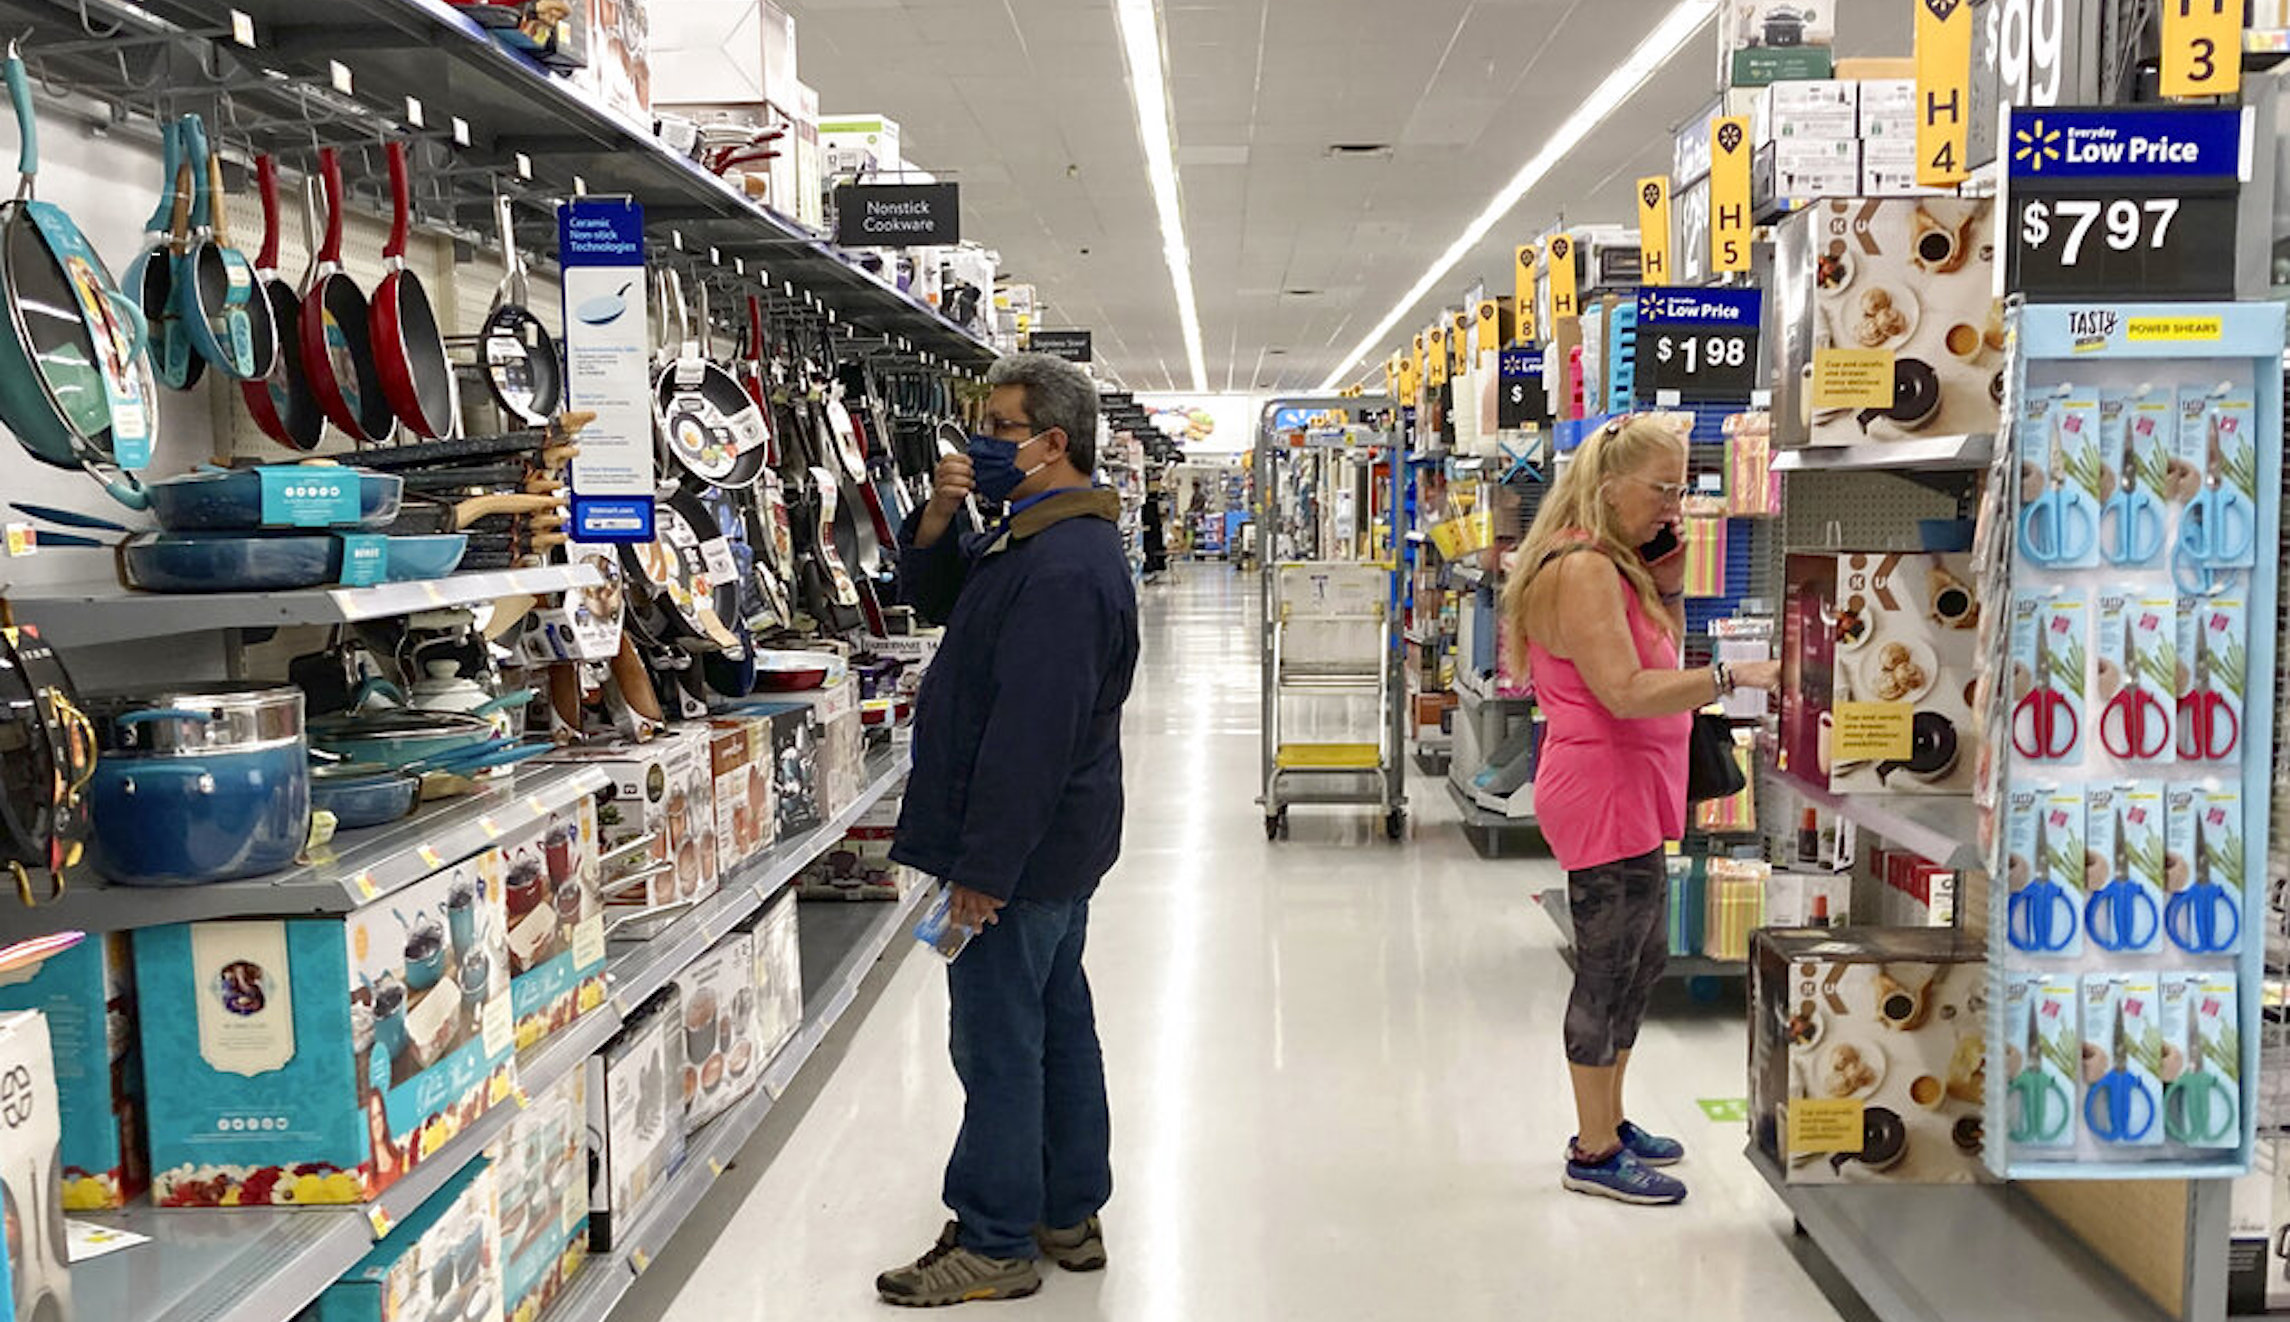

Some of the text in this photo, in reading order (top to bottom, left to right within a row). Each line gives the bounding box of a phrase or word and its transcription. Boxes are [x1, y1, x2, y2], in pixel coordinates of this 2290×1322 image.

[2187, 38, 2215, 82] 3
[1927, 89, 1959, 126] H
[2067, 126, 2117, 140] Everyday
[1932, 140, 1956, 173] 4
[2065, 135, 2199, 163] Low Price
[866, 200, 931, 215] Nonstick
[569, 216, 612, 229] Ceramic
[861, 216, 935, 232] Cookware
[1719, 203, 1742, 231] H
[569, 229, 618, 241] Non-stick
[570, 241, 636, 254] Technologies
[1723, 240, 1739, 265] 5
[1645, 250, 1663, 274] H
[1520, 299, 1534, 315] H
[1556, 294, 1571, 313] H
[1667, 303, 1740, 319] Low Price
[1522, 320, 1533, 337] 8
[2069, 310, 2118, 336] TASTY
[2129, 323, 2218, 334] POWER SHEARS
[1510, 383, 1523, 403] $
